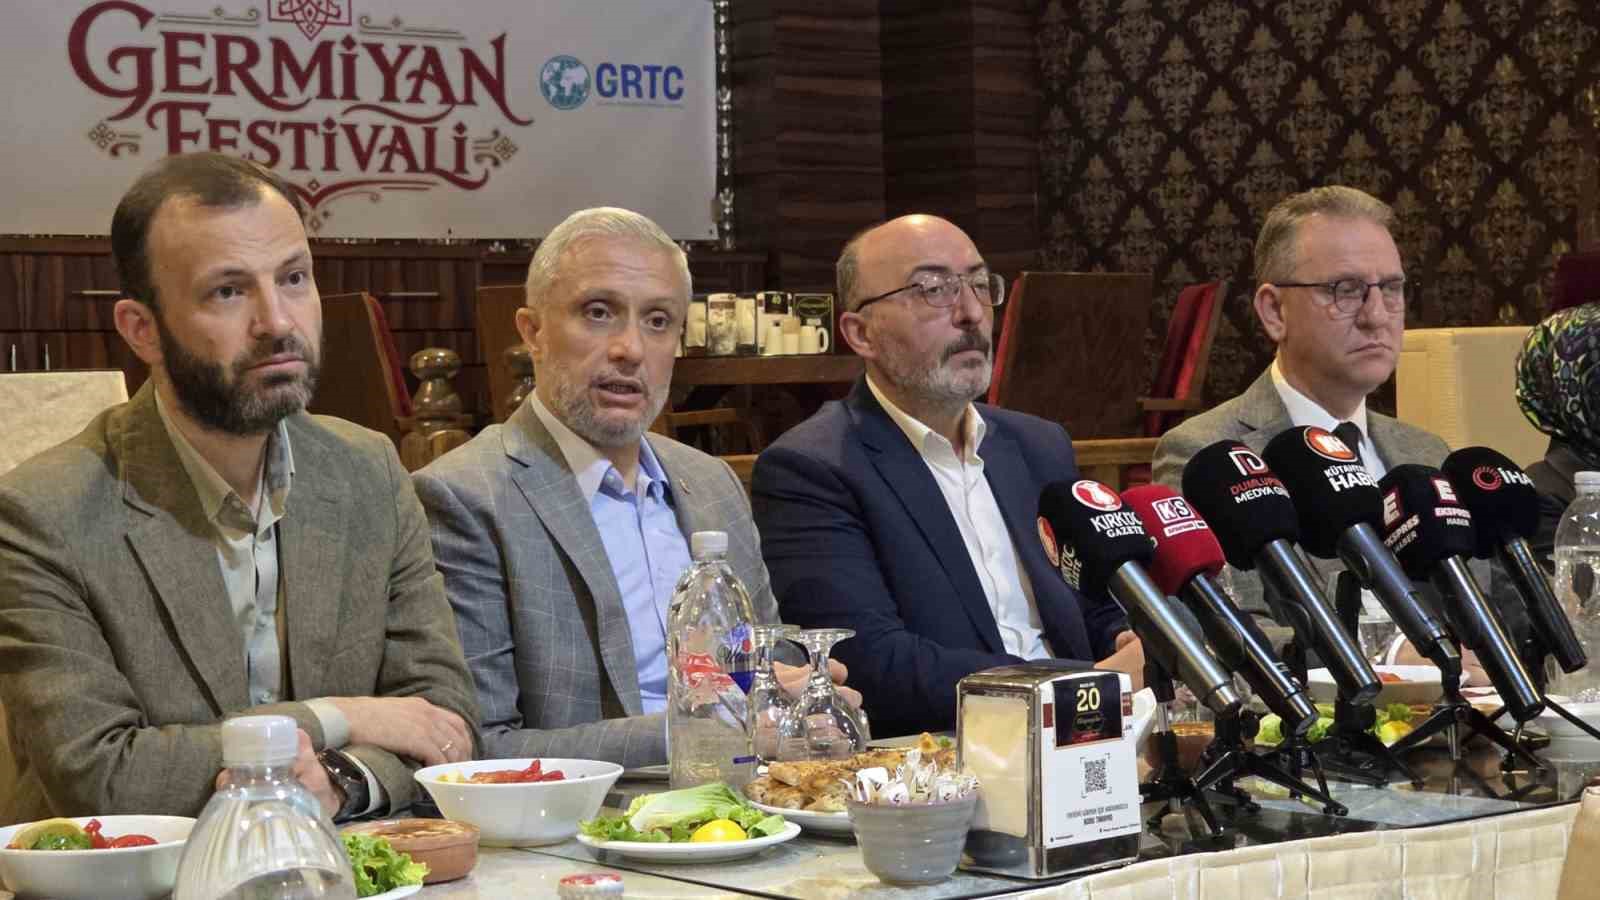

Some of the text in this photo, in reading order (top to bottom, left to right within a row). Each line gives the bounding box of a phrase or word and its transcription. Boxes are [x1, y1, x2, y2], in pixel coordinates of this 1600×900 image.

[68, 0, 534, 126] GERMİYAN
[595, 62, 684, 101] GRTC
[1434, 479, 1456, 501] E
[1383, 492, 1400, 527] E
[1076, 687, 1101, 713] 20
